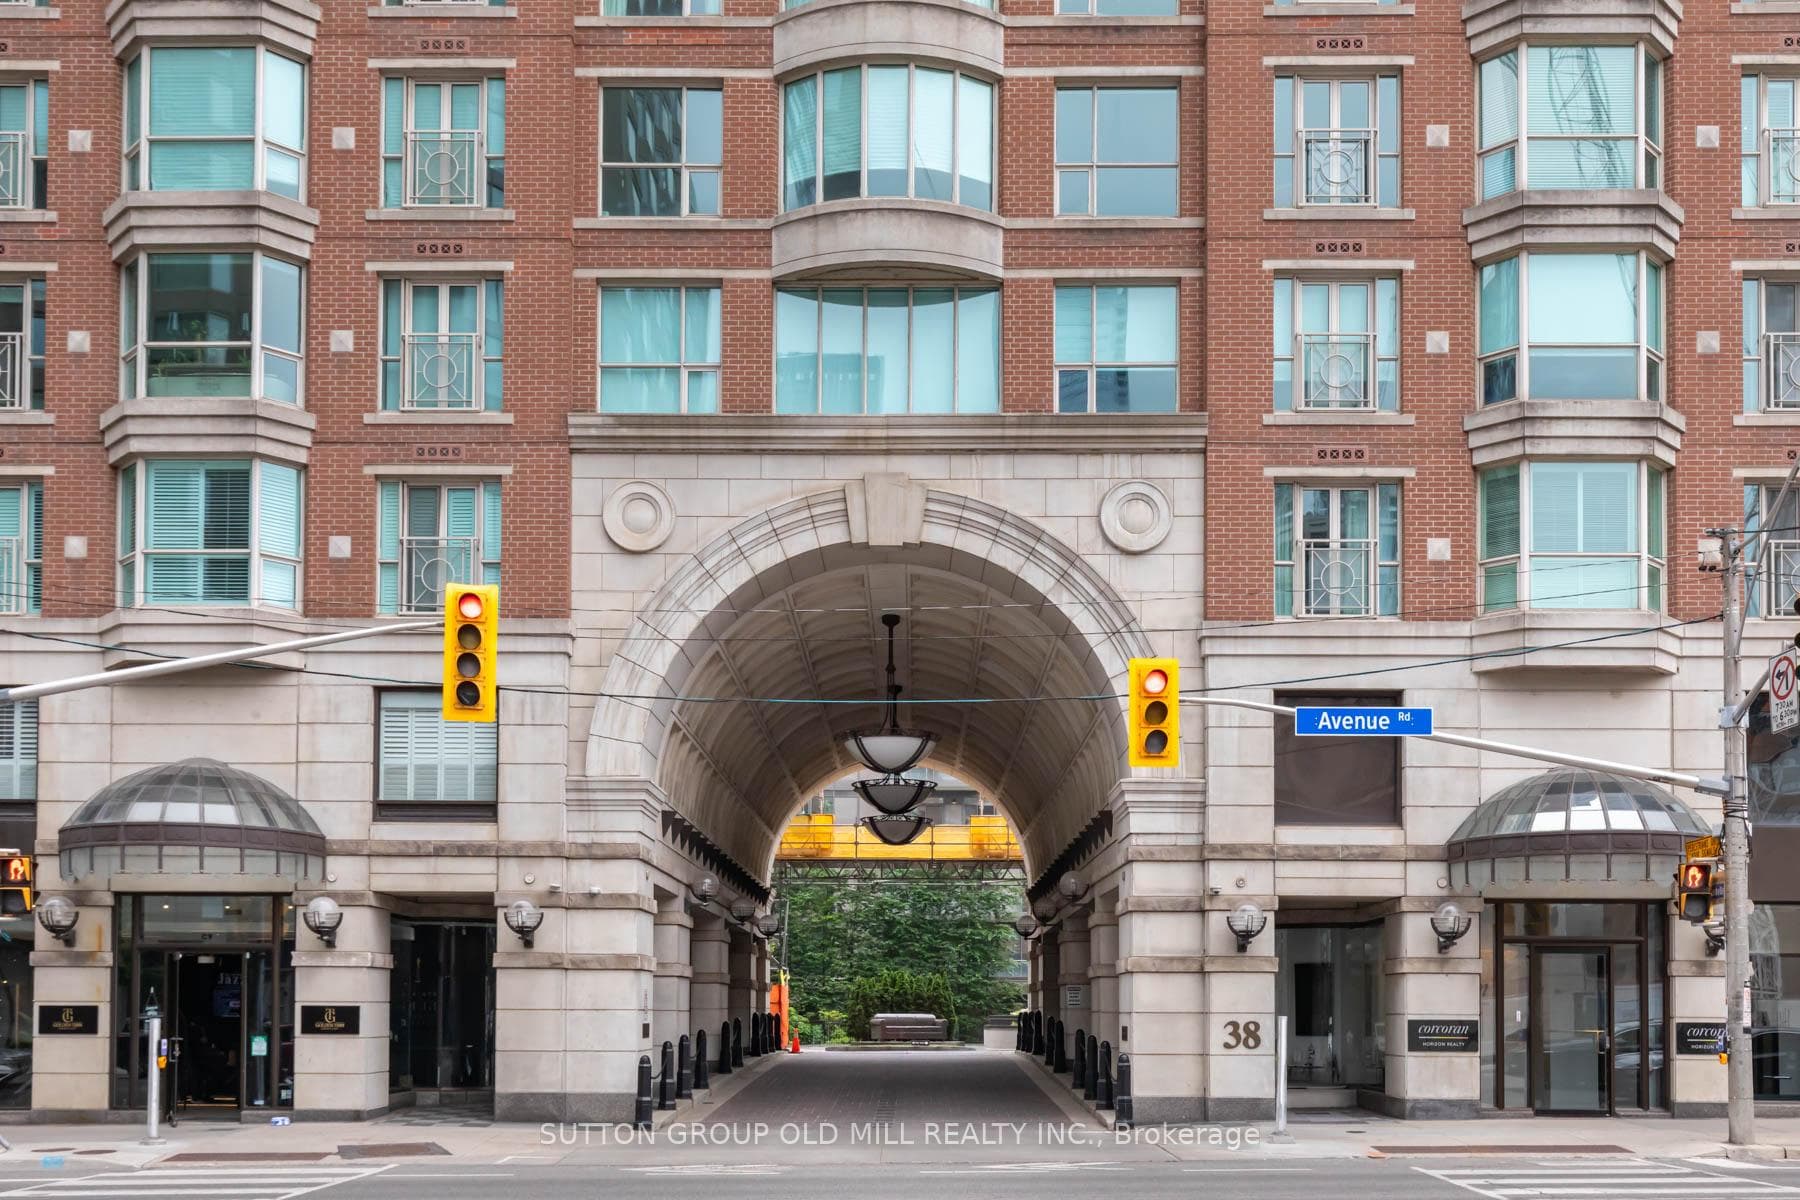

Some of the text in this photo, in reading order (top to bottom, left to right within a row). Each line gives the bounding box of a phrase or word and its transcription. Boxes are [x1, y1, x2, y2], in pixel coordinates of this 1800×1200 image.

[1318, 711, 1411, 730] Avenue Rd
[1223, 1020, 1261, 1049] 38
[1418, 1024, 1469, 1035] corcoran
